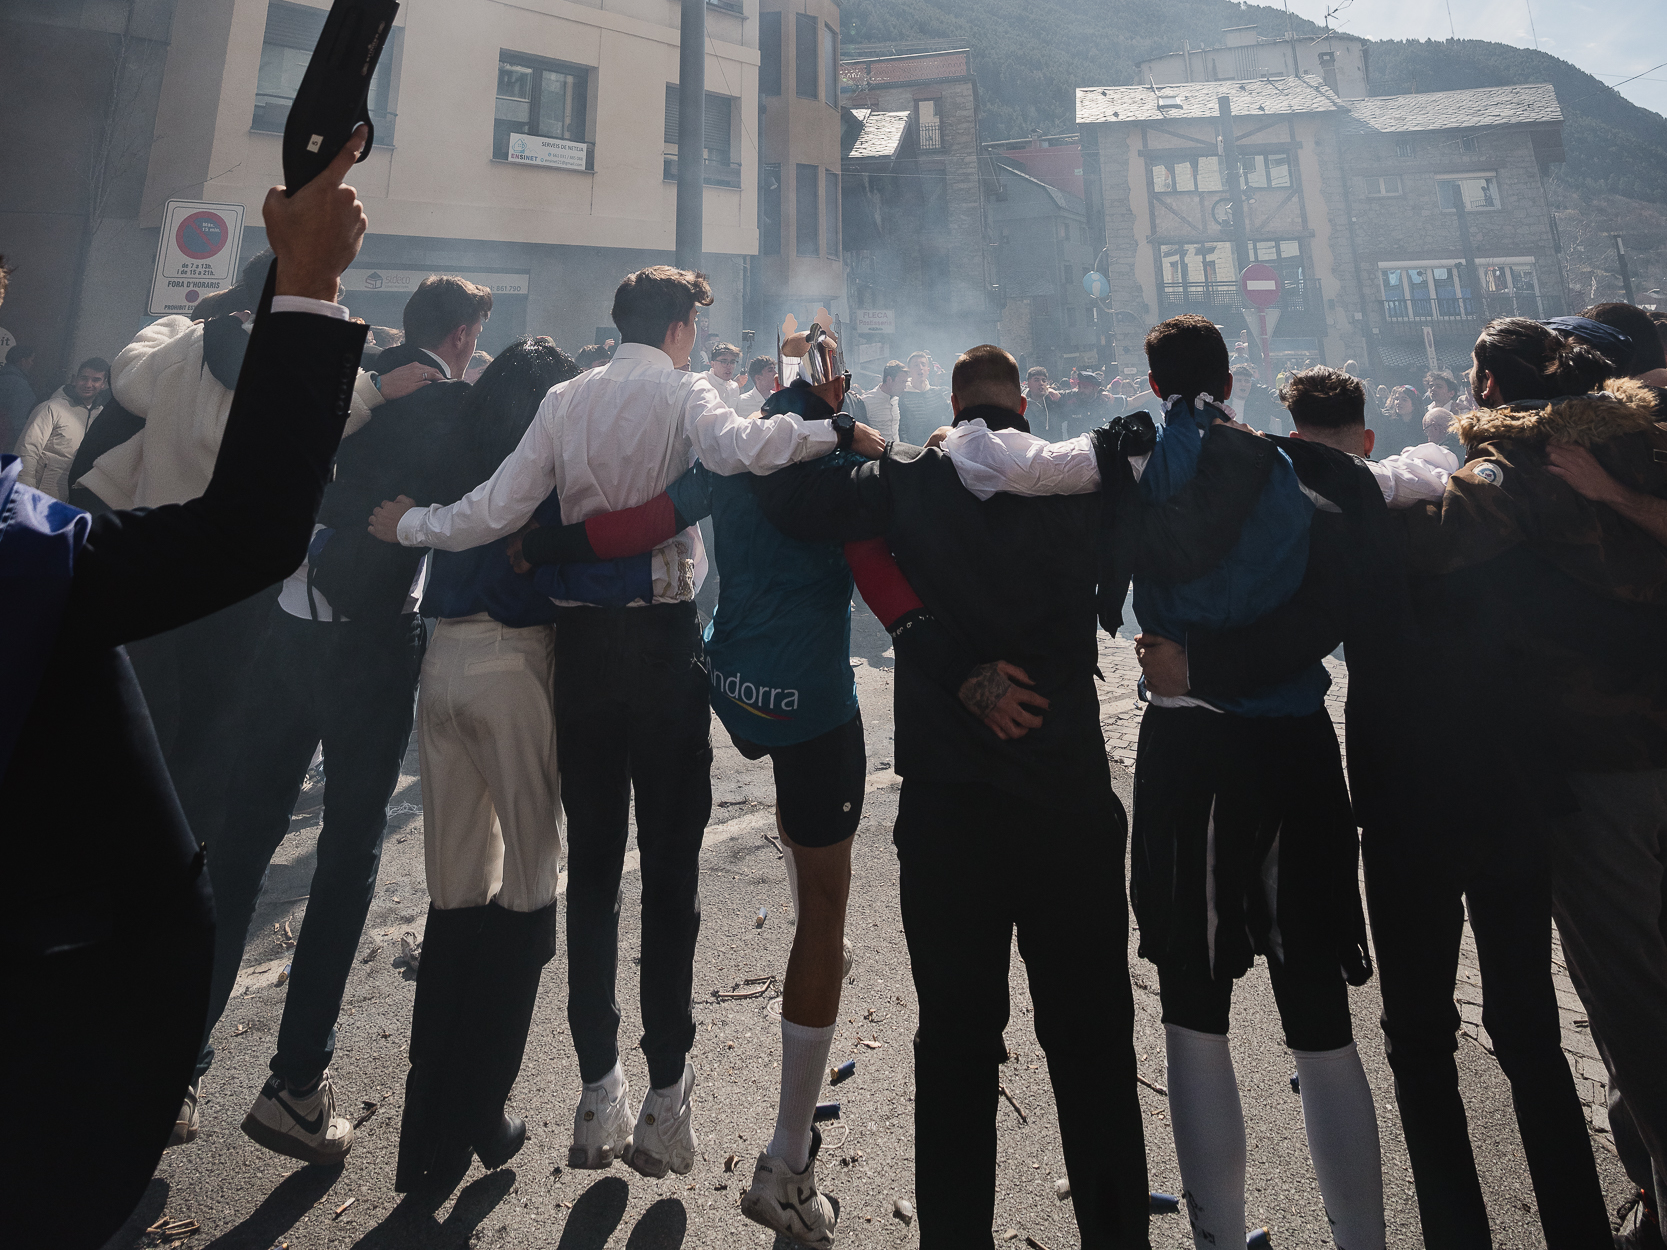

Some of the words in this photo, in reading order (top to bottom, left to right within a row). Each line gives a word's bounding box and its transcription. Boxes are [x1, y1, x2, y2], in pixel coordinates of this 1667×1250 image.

[541, 141, 560, 150] SERVEIS
[510, 153, 539, 162] ENSINET
[167, 280, 185, 288] FORA
[186, 281, 221, 289] D'HORARIS
[862, 311, 889, 319] FLECA
[706, 655, 800, 711] Andorra
